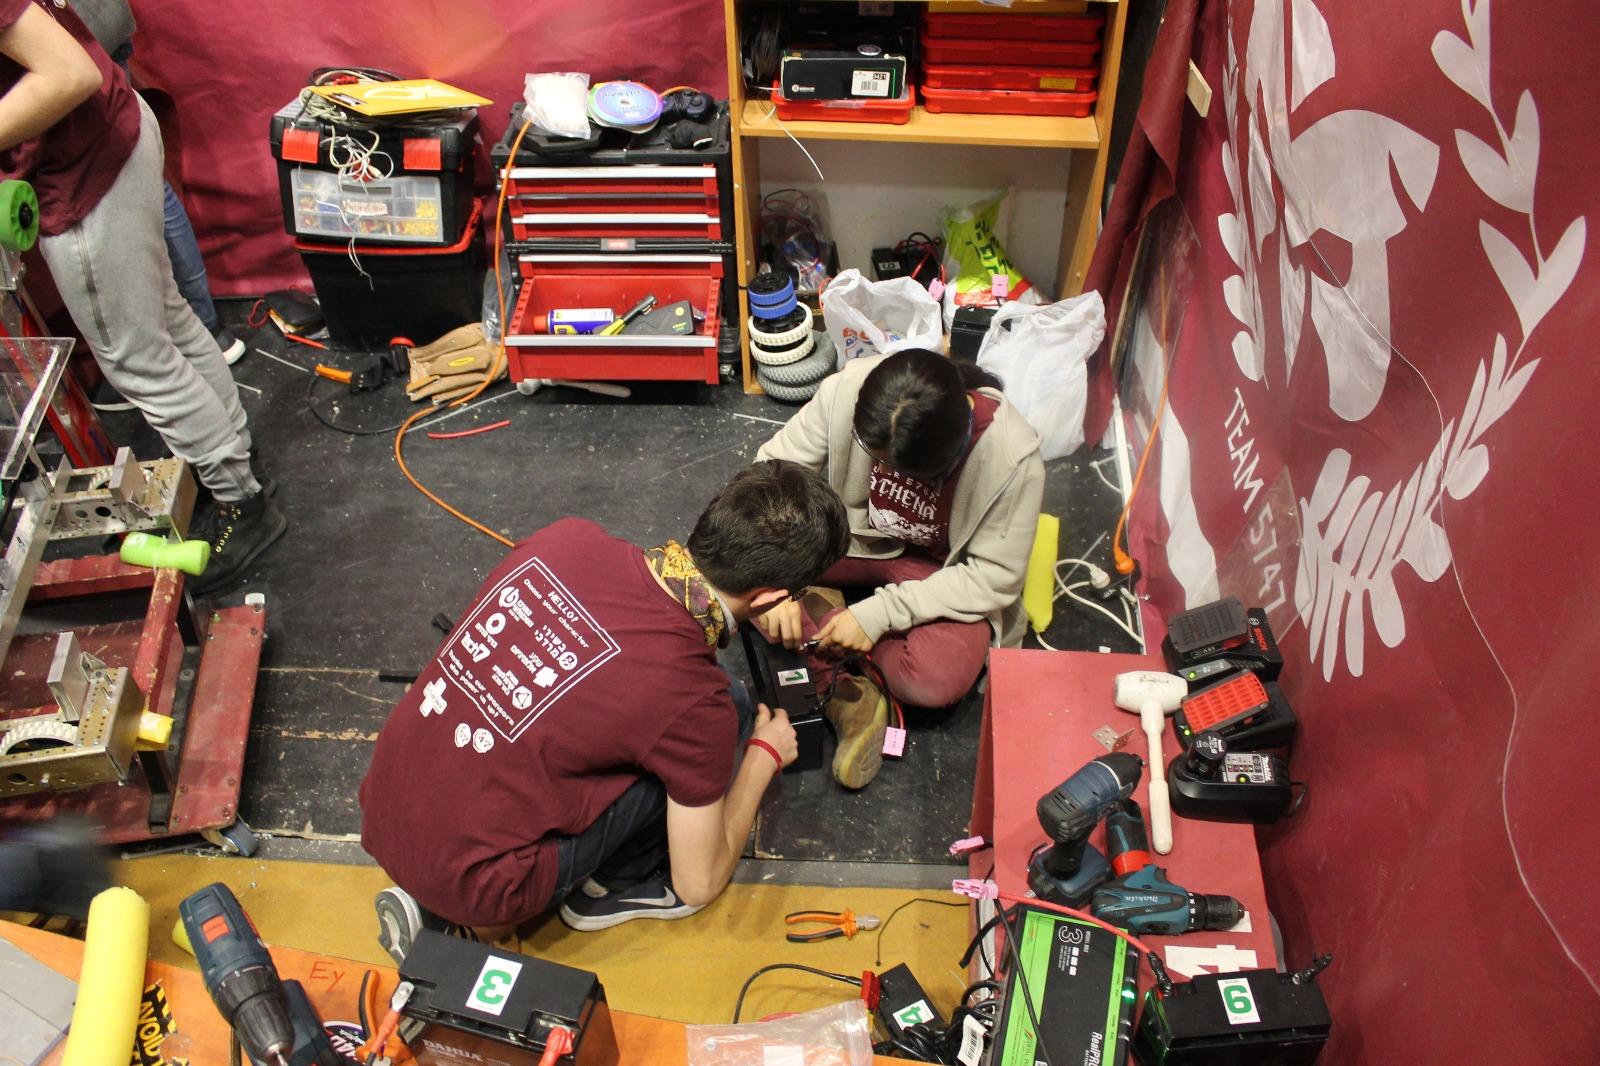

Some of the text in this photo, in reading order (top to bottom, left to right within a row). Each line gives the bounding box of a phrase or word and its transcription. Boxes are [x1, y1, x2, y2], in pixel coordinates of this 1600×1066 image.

[1224, 387, 1286, 614] TEAM 5747
[523, 578, 589, 649] Choose your character
[547, 590, 579, 624] HELLO!
[1254, 627, 1268, 652] BOSCH
[474, 678, 486, 692] our
[485, 691, 515, 726] sponsors
[476, 968, 512, 1004] 3
[899, 1006, 922, 1025] 4
[422, 1038, 485, 1063] DAHUA
